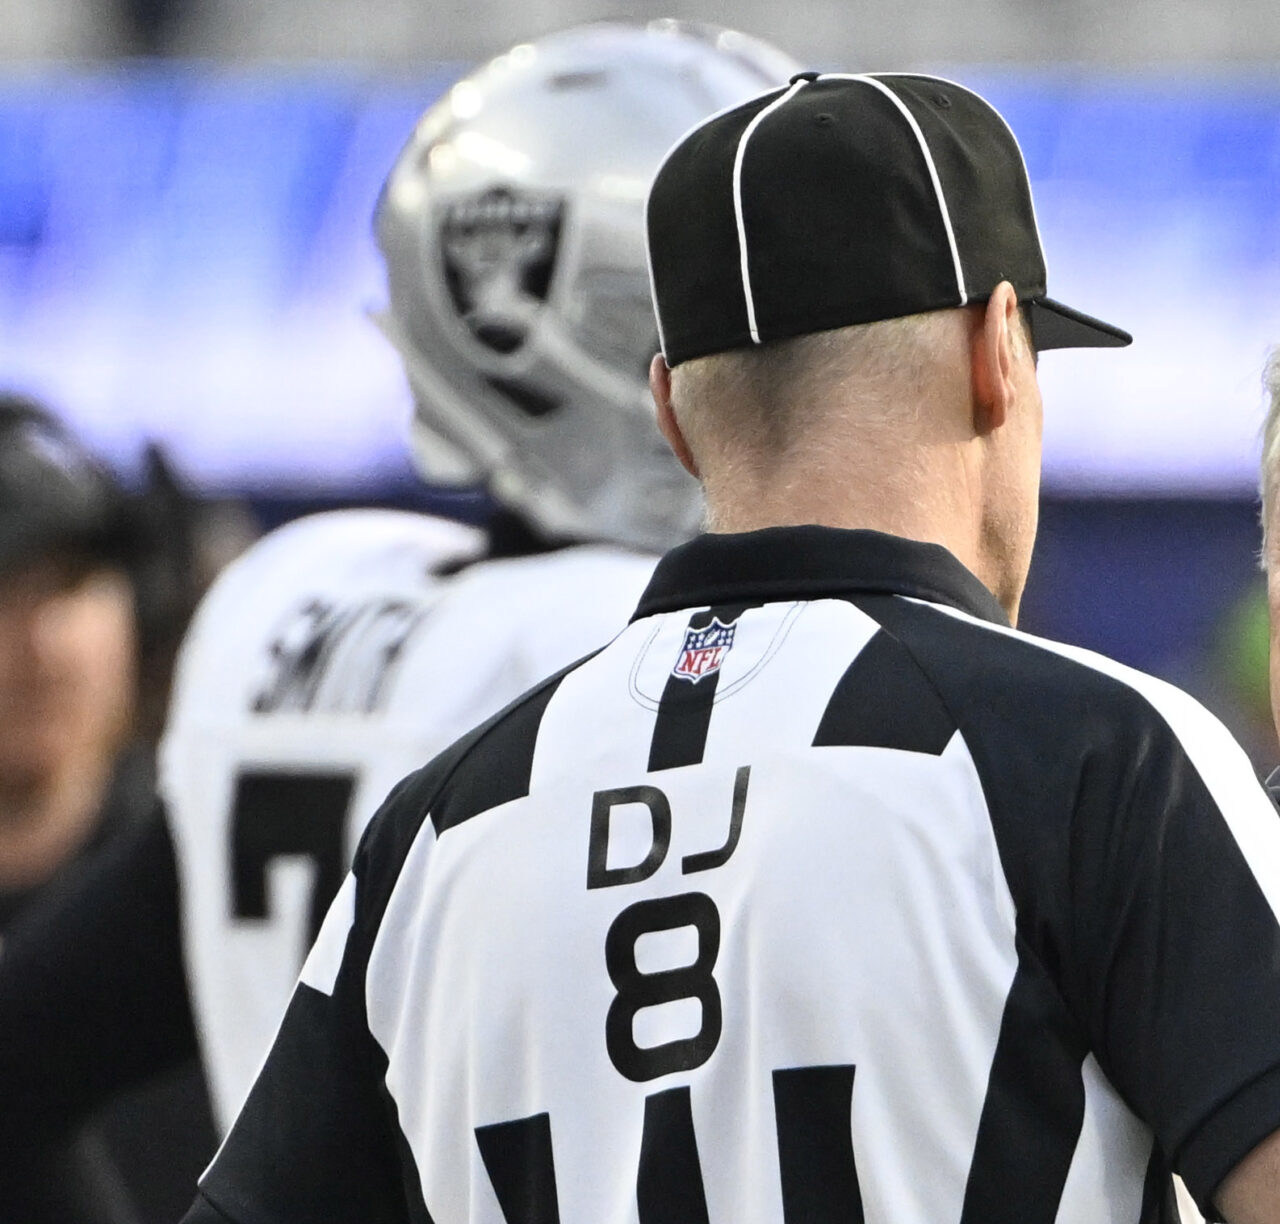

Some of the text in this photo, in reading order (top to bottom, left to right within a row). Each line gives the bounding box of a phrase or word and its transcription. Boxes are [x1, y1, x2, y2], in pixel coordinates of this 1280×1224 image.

[678, 647, 722, 674] NFL
[229, 764, 358, 970] 7
[587, 765, 751, 890] DJ
[605, 891, 722, 1083] 8
